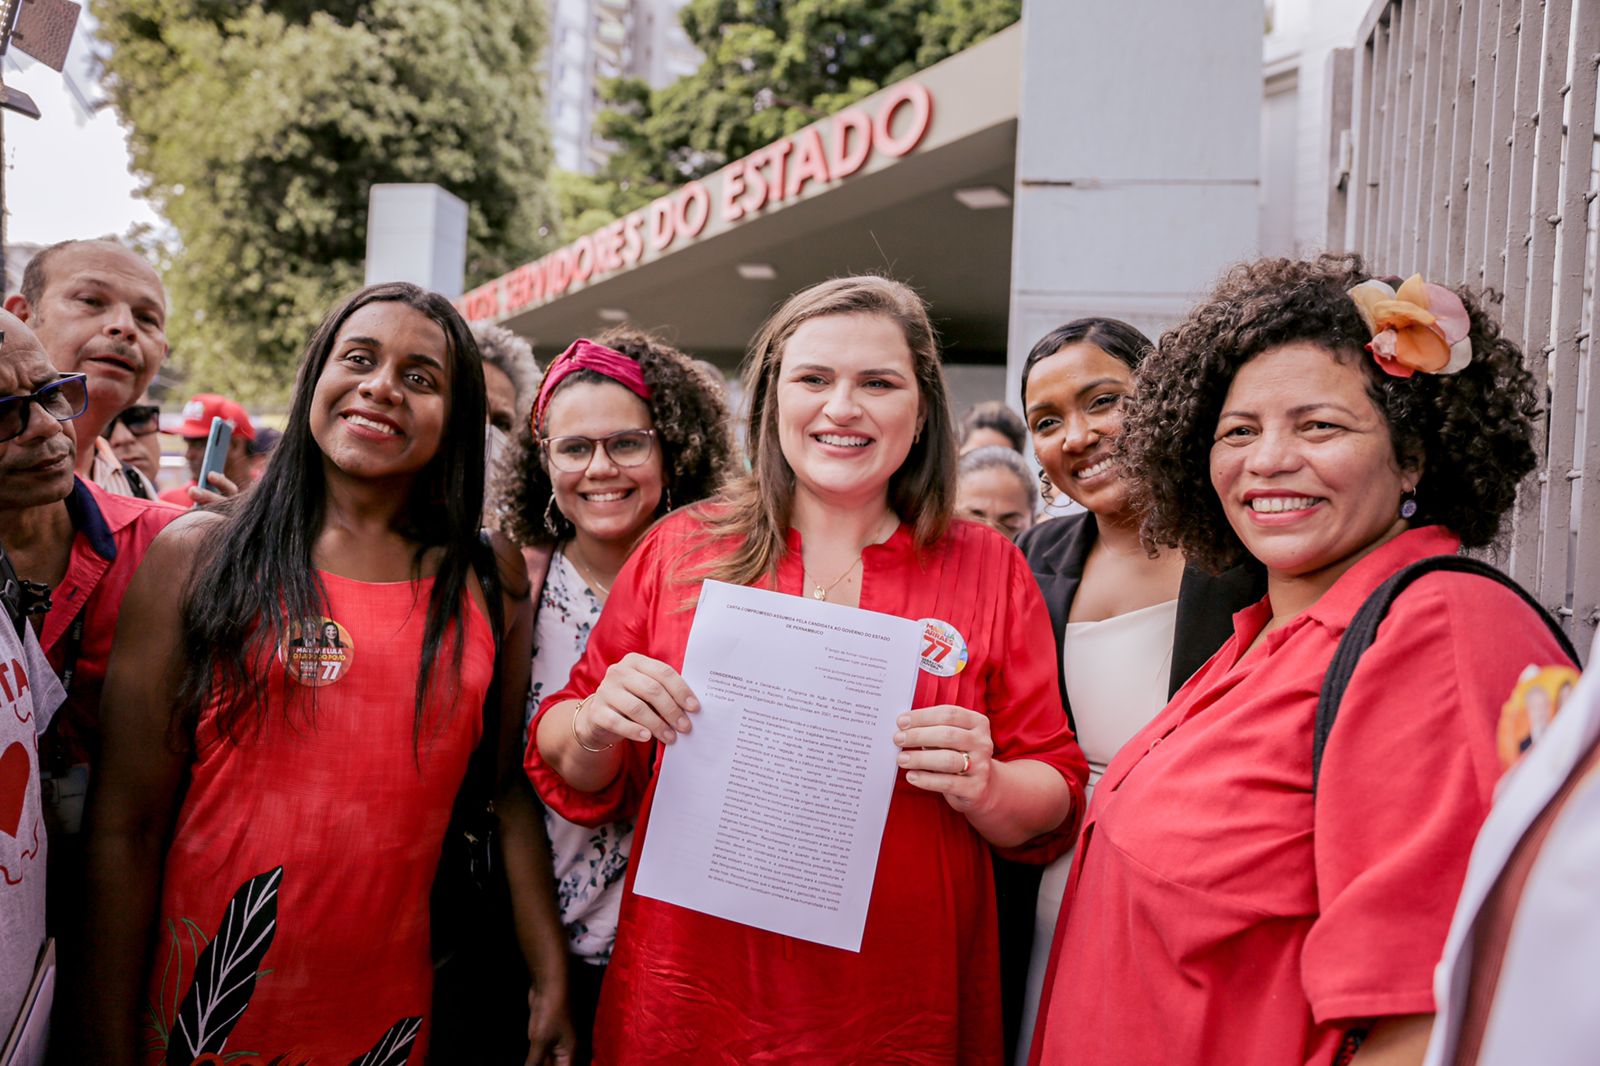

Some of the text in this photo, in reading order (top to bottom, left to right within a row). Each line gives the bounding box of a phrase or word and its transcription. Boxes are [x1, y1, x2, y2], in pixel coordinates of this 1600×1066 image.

[502, 211, 645, 313] SERVIDORES
[650, 180, 710, 250] DO
[720, 80, 933, 222] ESTADO
[740, 606, 773, 617] COMPROMISSO
[772, 613, 795, 622] ASSUMIDA
[807, 619, 833, 629] CANDIDATA
[841, 627, 864, 636] GOVERNO
[871, 633, 891, 642] ESTADO
[792, 624, 824, 635] PERNAMBUCO
[921, 634, 952, 664] 77
[925, 629, 954, 646] ARRAES
[321, 661, 342, 680] 77
